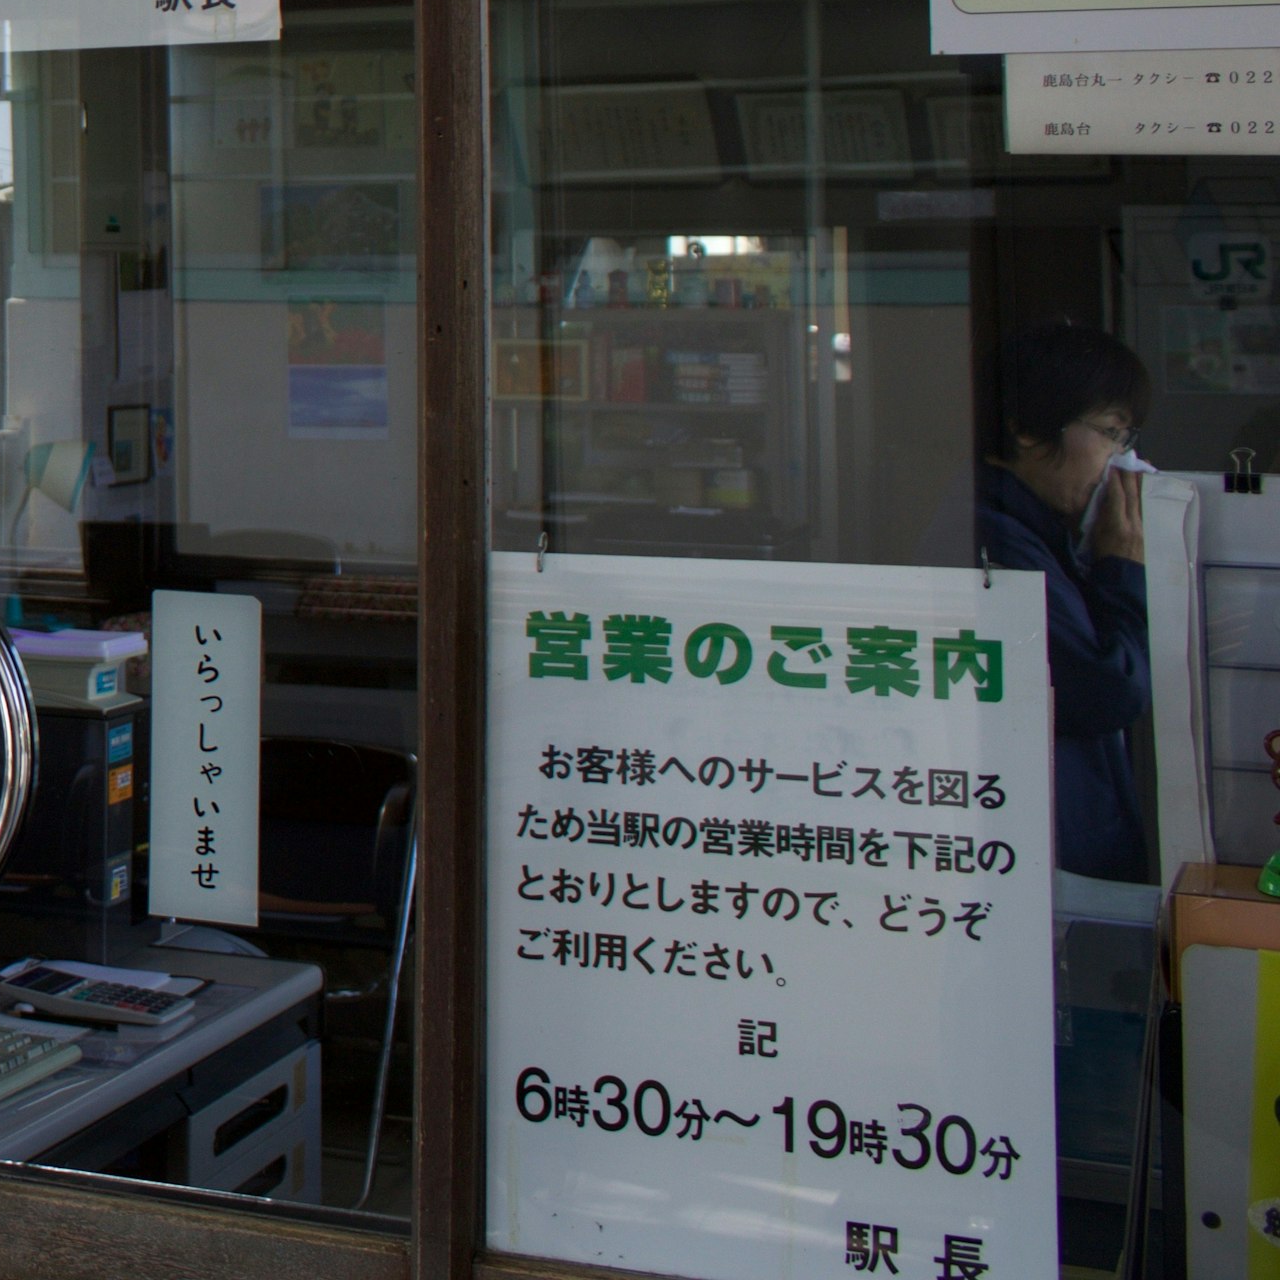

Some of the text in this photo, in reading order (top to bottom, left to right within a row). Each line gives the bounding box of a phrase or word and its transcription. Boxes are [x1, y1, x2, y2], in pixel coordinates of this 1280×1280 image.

[1133, 72, 1193, 86] タクシー
[1044, 122, 1091, 136] 鹿島台
[1135, 122, 1196, 134] タクシー
[525, 611, 1005, 703] 営業のご案内
[192, 625, 223, 889] いらっしゃいませ
[539, 744, 1007, 811] お客様へのサービスを図る
[516, 803, 1017, 877] ため当駅の営業時間を下記の
[516, 865, 993, 943] とおりとしますので、どうぞ
[515, 926, 787, 989] ご利用ください。
[738, 1019, 779, 1059] 記
